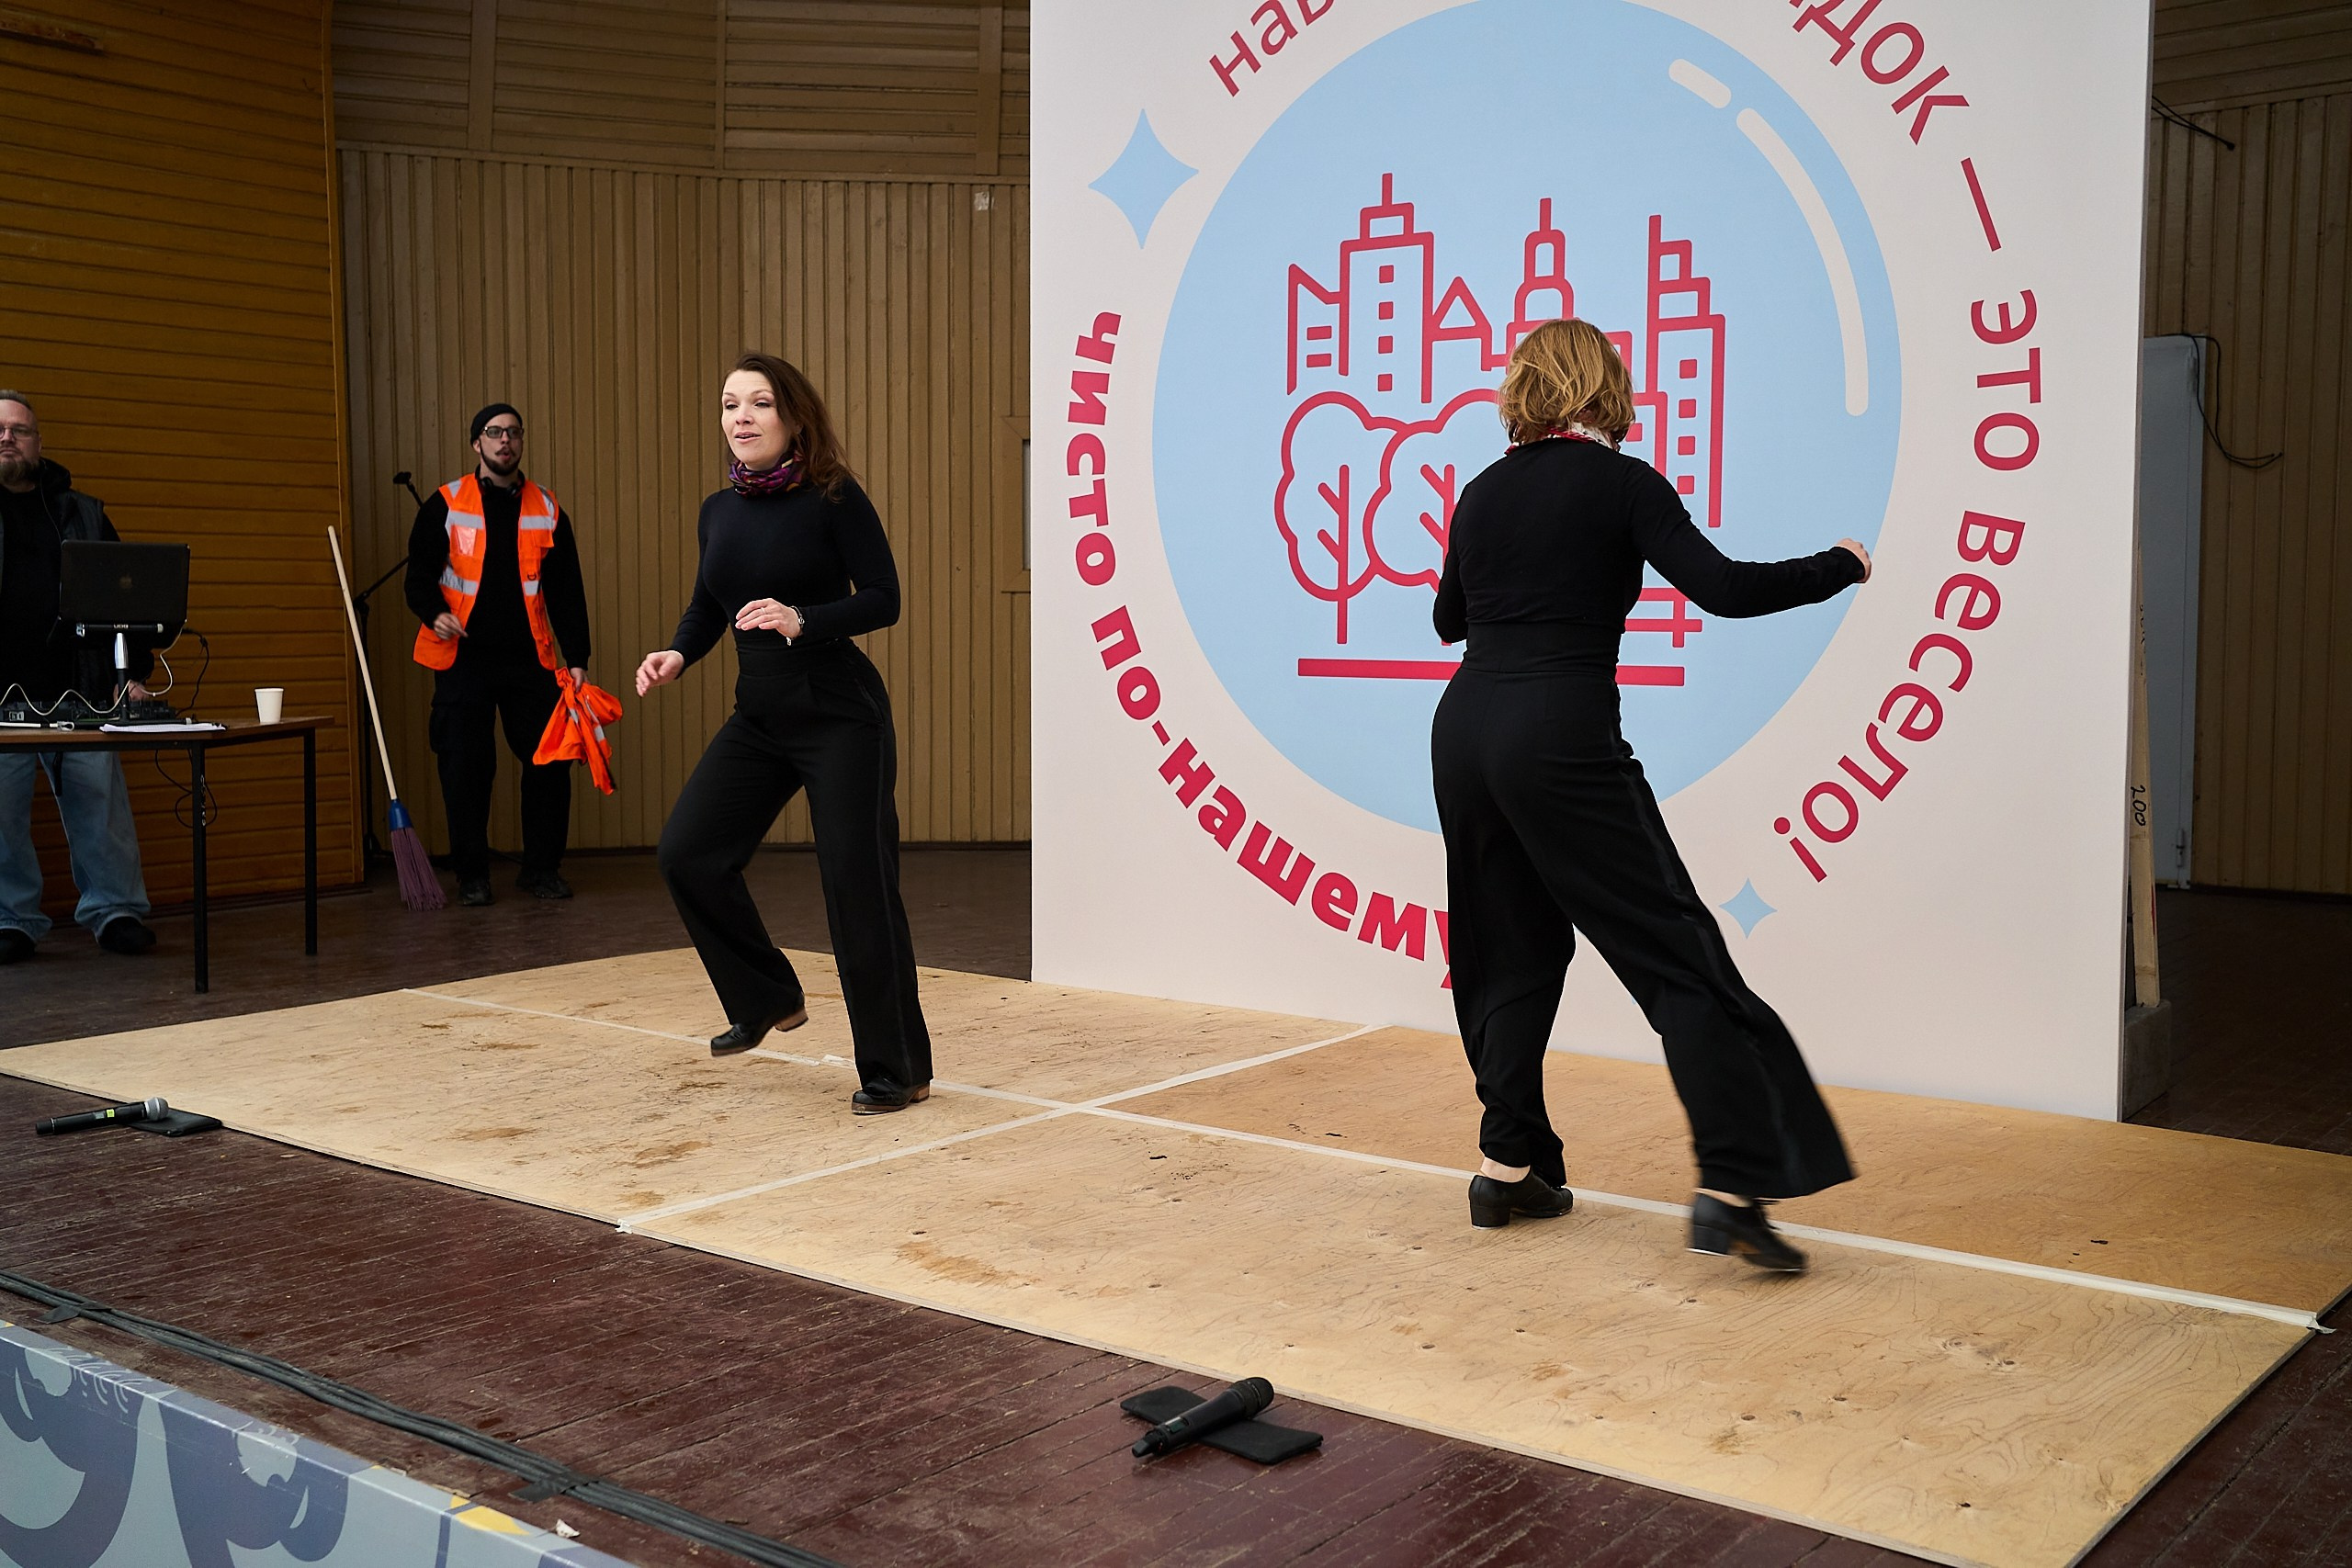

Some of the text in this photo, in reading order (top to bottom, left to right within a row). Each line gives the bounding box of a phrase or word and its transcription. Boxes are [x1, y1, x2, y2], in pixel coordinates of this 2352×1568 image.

[1789, 0, 1971, 146] док
[1067, 310, 1122, 587] чисто
[1971, 288, 2042, 472] это
[1773, 510, 2027, 884] весело!
